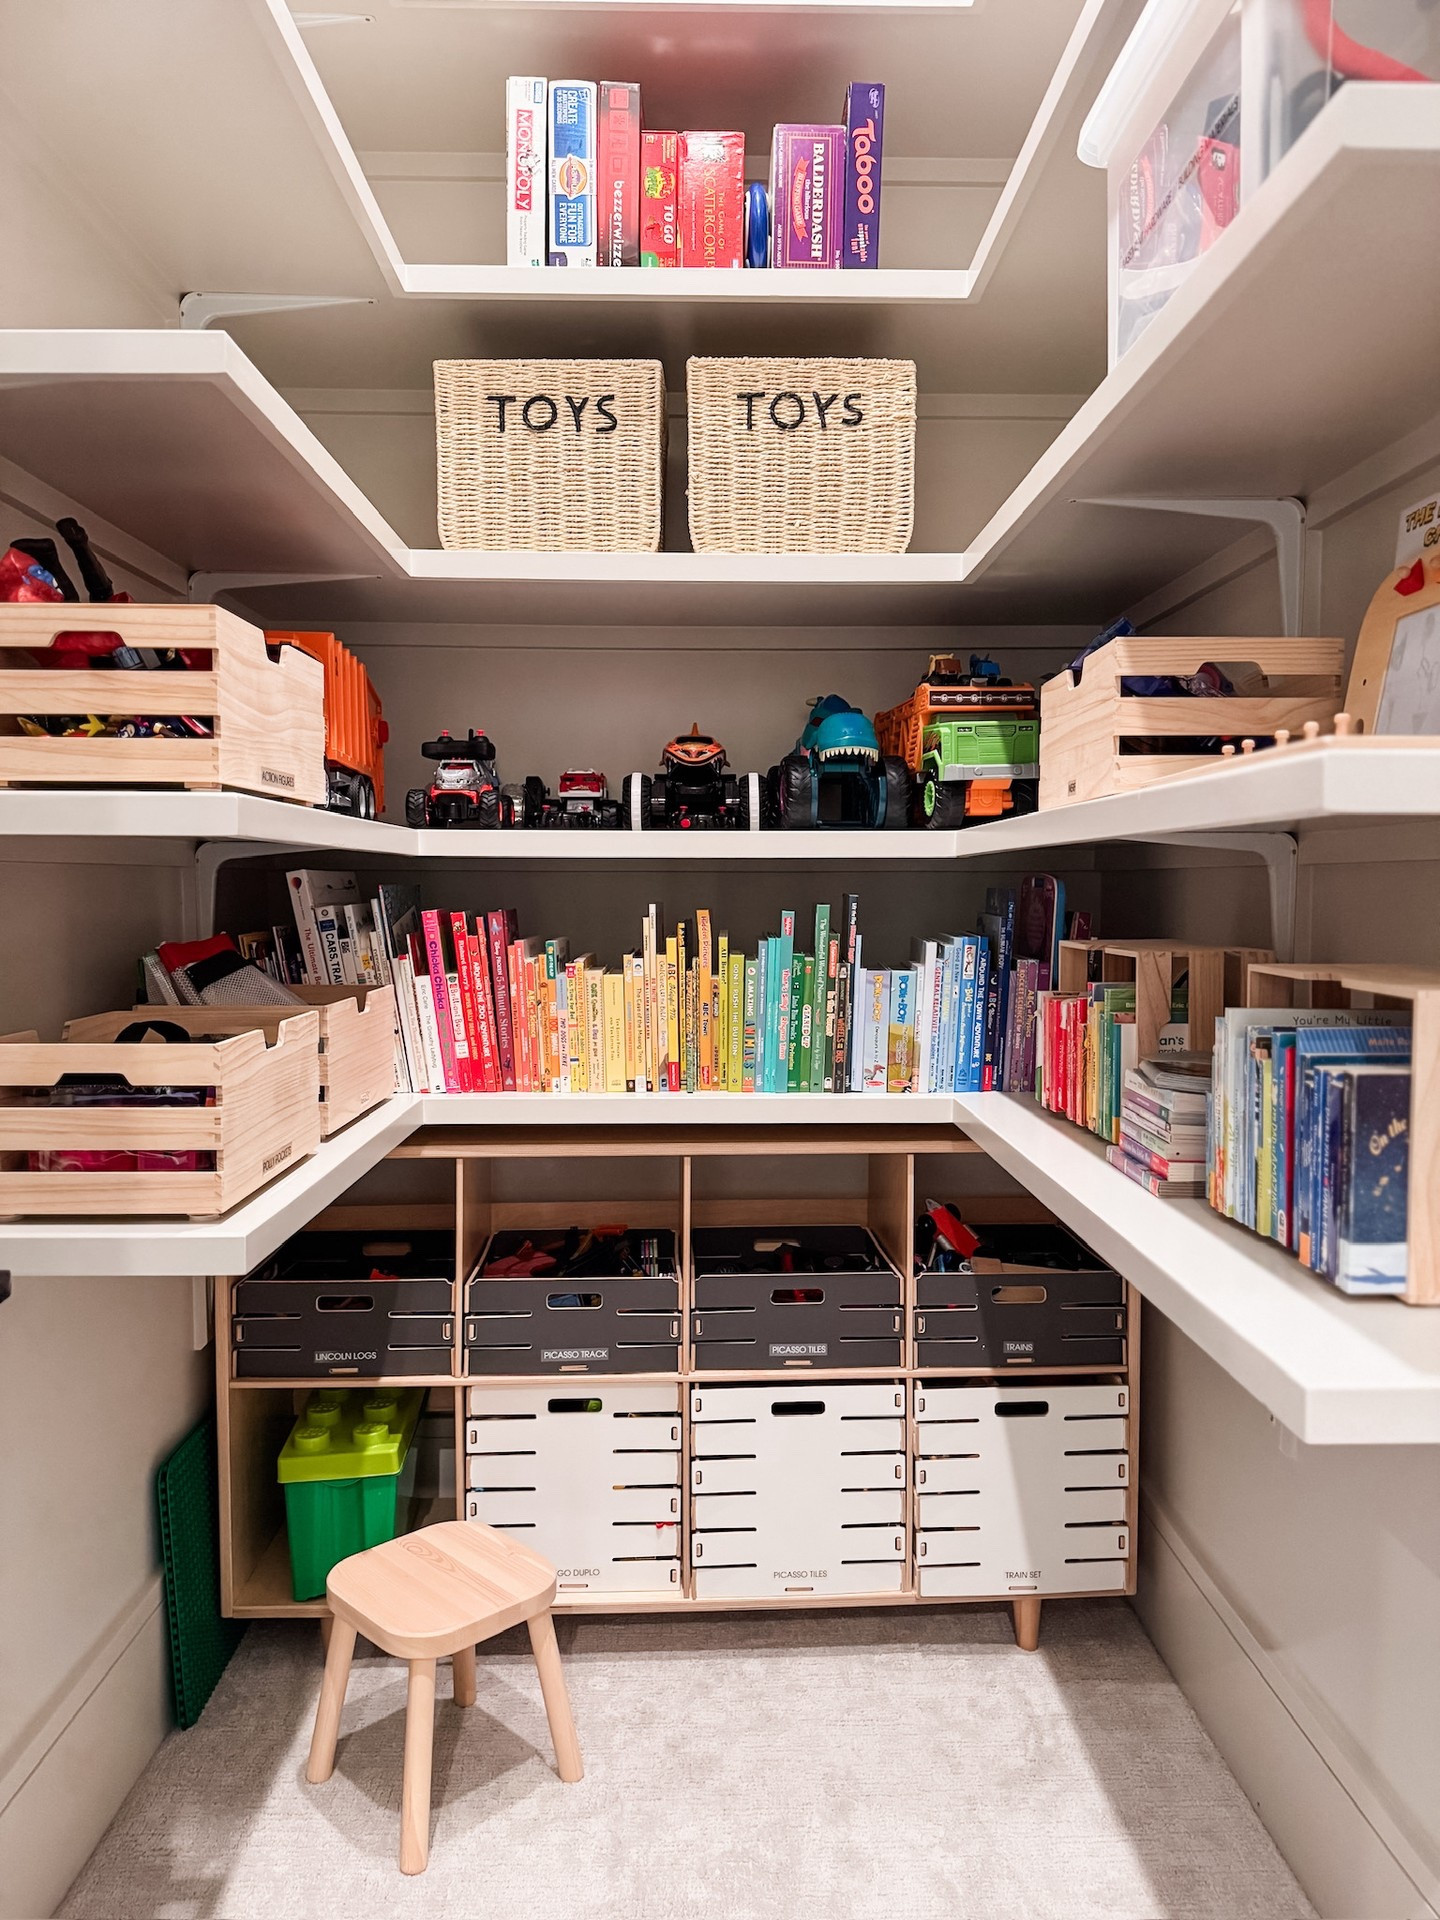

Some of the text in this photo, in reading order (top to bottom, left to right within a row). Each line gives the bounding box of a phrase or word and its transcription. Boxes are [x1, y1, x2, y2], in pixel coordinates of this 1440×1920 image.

[568, 90, 577, 124] CREATE
[516, 110, 532, 210] MONOPOLY
[852, 119, 877, 214] Taboo
[811, 143, 824, 257] BALDERDASH
[568, 203, 577, 243] FUN FOR
[613, 180, 624, 266] bezzerwizze
[664, 205, 674, 244] TO GO
[718, 238, 724, 249] OF
[487, 395, 618, 433] TOYS
[737, 390, 864, 431] TOYS
[1406, 501, 1437, 533] THE
[262, 771, 295, 788] ACTION FIGURES
[326, 933, 336, 961] CARS,
[701, 916, 710, 968] Hidden Pictures
[818, 929, 827, 959] Wonderful
[308, 944, 318, 974] Ultimate
[667, 963, 676, 980] ABC
[429, 941, 439, 974] Chicka
[435, 976, 444, 1009] Chicka
[473, 962, 482, 990] AROUND
[480, 1021, 490, 1057] ADVENTURE
[496, 976, 509, 1016] 5-Minute
[965, 988, 973, 1002] BIG
[989, 992, 997, 1007] ABC
[1016, 996, 1024, 1023] SCIENCE
[454, 1019, 462, 1036] Bugs
[669, 1009, 676, 1021] Me
[702, 1003, 710, 1036] ABC Town
[744, 979, 755, 1069] AMAZING ANIMALS
[779, 969, 790, 1060] That's Silly! Rhyme Time
[802, 1004, 811, 1048] GEARED UP
[825, 991, 836, 1036] In the Forest
[931, 998, 939, 1033] RELATIVITY
[1025, 1015, 1033, 1037] Physics
[1293, 1016, 1392, 1026] You're My Little
[501, 1019, 510, 1048] Stories
[790, 1020, 798, 1040] Truck's
[836, 1018, 845, 1043] WHEELS
[973, 1022, 982, 1058] ADVENTURE
[1159, 1037, 1184, 1046] an's
[788, 1042, 796, 1070] Springtime
[836, 1050, 844, 1063] BUS
[1369, 1117, 1408, 1157] On the
[263, 1145, 293, 1173] POLLY POCKETS
[315, 1351, 377, 1361] LINCOLN LOGS
[544, 1349, 608, 1359] PICASSO TRACK
[772, 1344, 826, 1354] PICASSO TILES
[1006, 1343, 1032, 1351] TRAINS
[557, 1568, 600, 1577] GO DUPLO
[773, 1570, 827, 1579] PICASSO TILES
[1005, 1571, 1041, 1579] TRAIN SET
